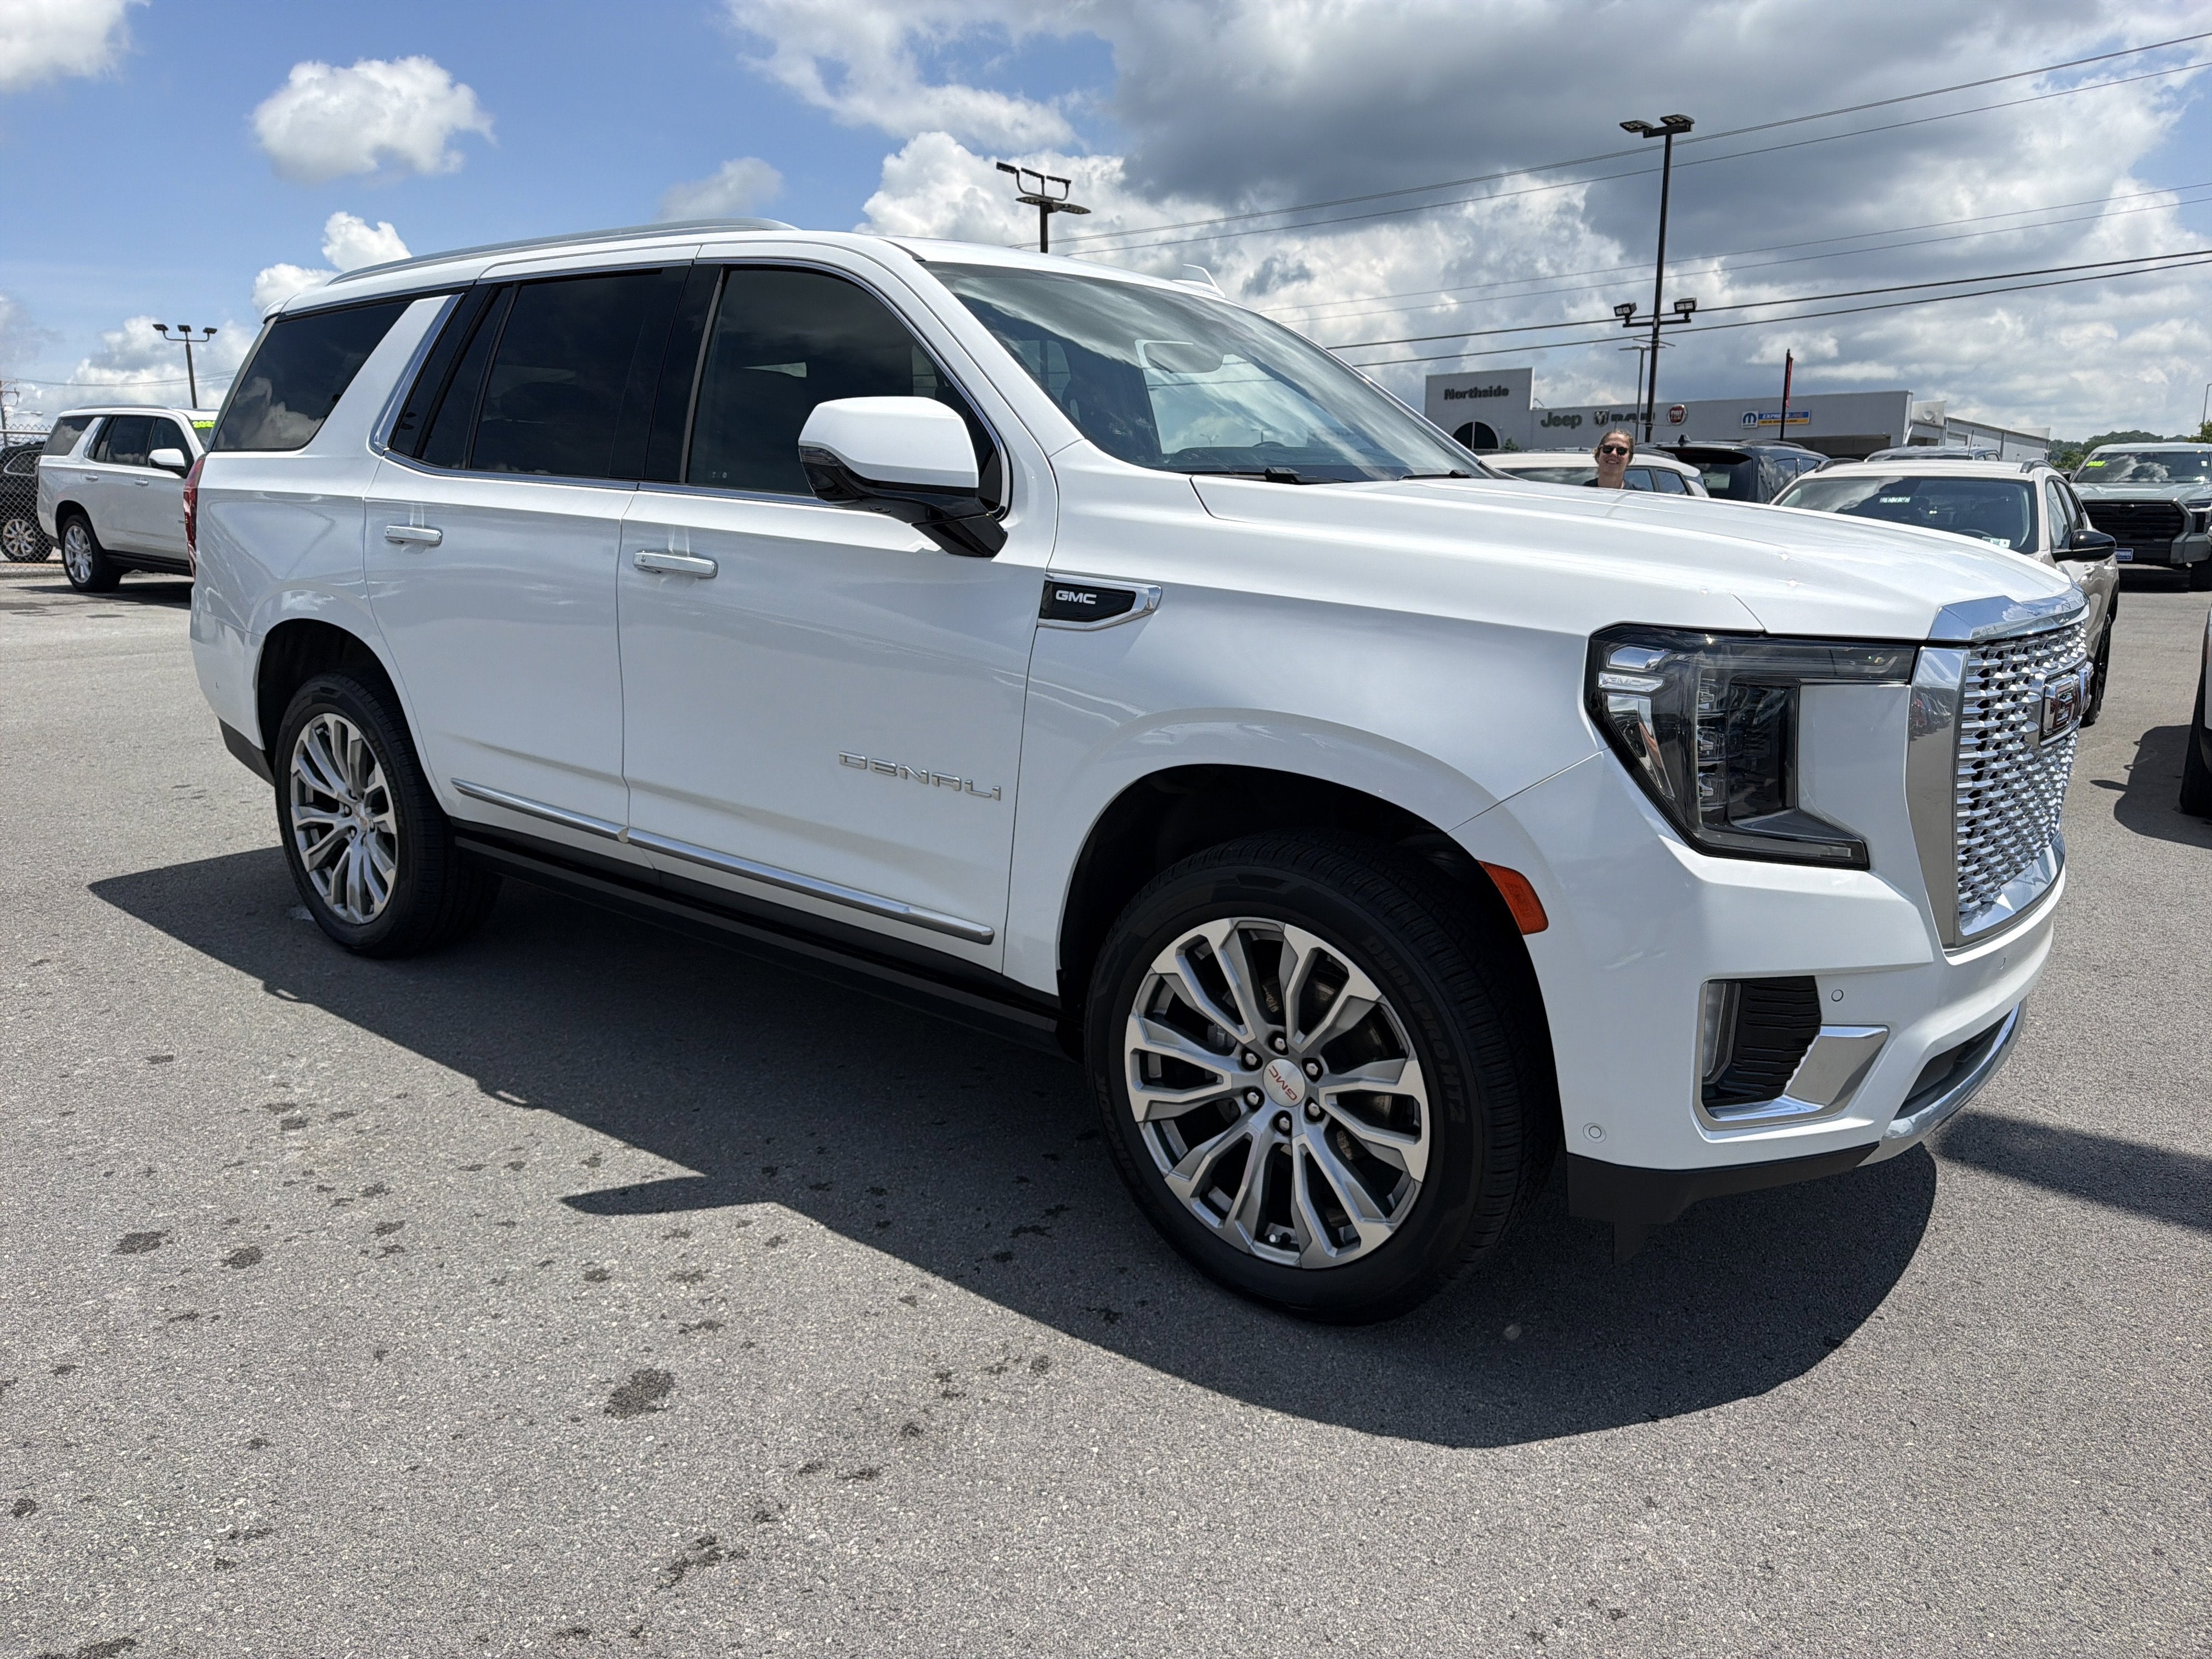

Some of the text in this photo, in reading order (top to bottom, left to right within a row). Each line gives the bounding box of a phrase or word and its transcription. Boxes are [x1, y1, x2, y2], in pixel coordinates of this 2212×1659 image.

[1443, 385, 1509, 400] Northside
[1541, 411, 1582, 429] Jeep
[1056, 590, 1097, 605] GMC
[839, 750, 1001, 801] DENALI
[1268, 1065, 1297, 1101] GMC
